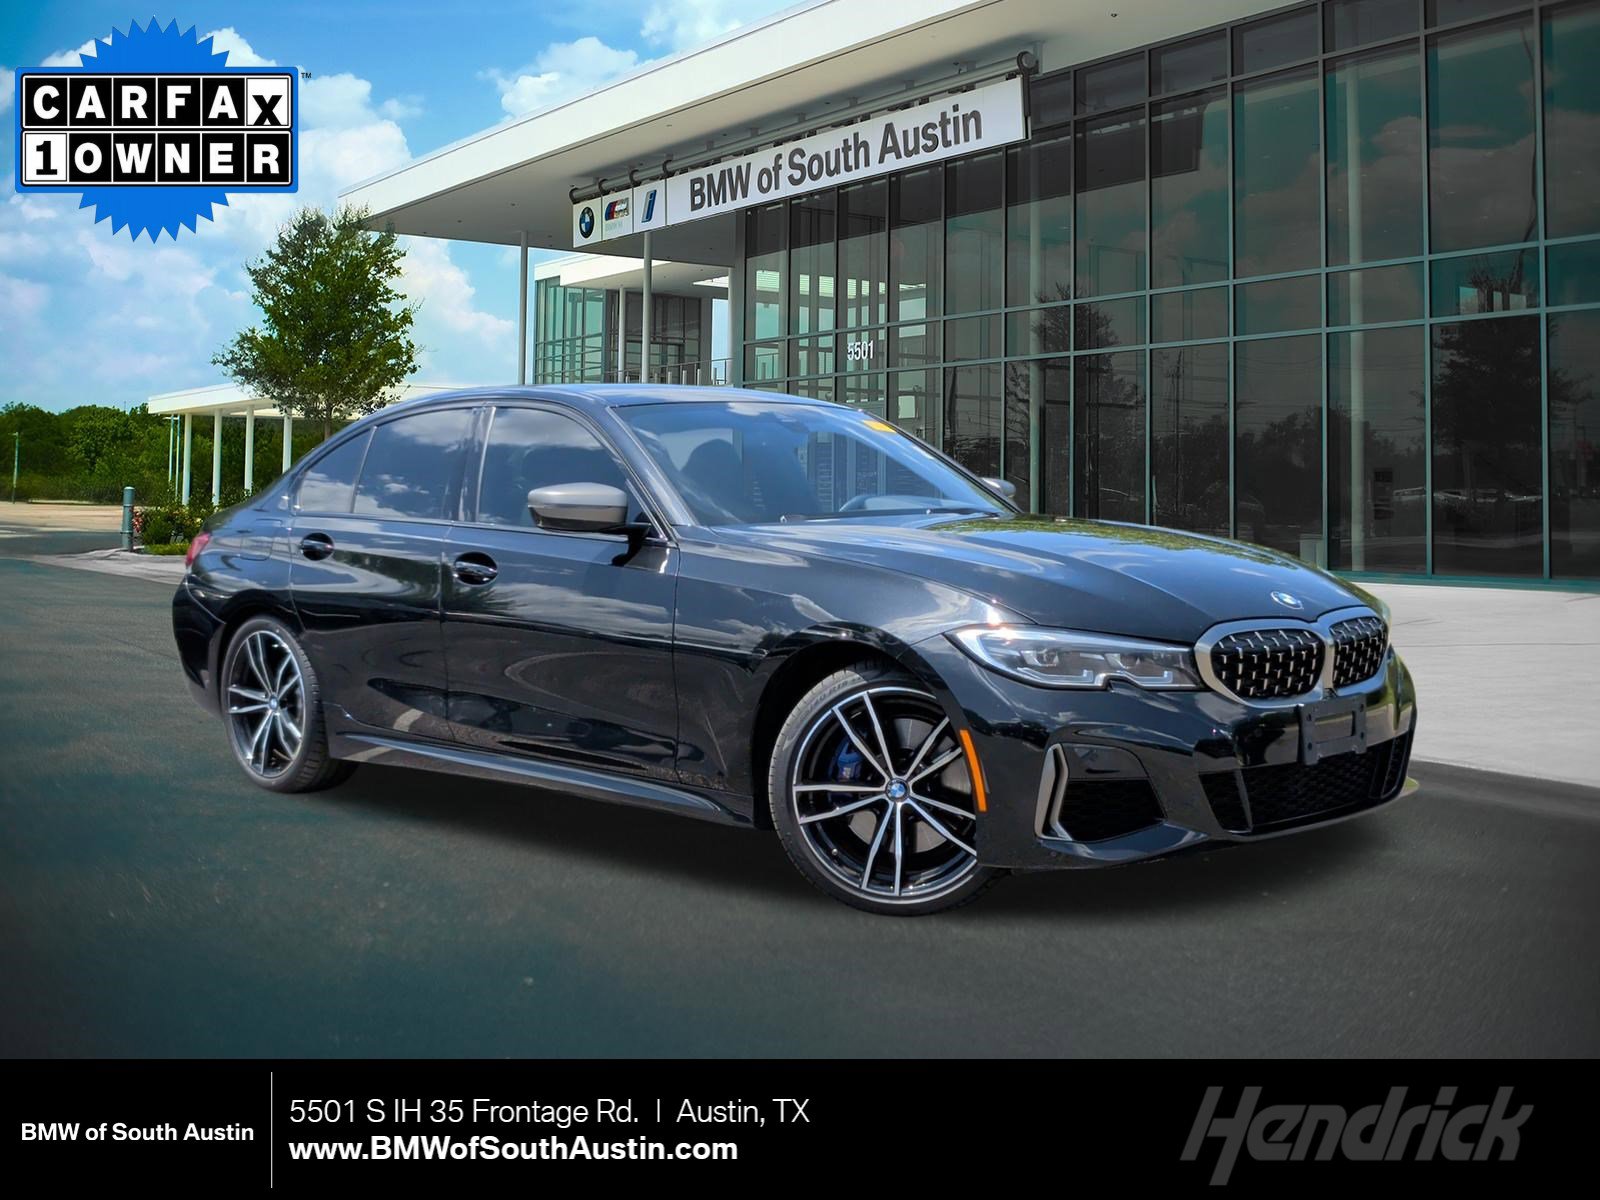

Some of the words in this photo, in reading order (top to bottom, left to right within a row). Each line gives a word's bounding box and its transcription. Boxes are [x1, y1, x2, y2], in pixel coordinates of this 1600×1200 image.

[689, 162, 752, 212] BMW
[756, 152, 784, 194] of
[787, 131, 871, 186] South
[878, 103, 983, 164] Austin
[847, 340, 874, 361] 5501
